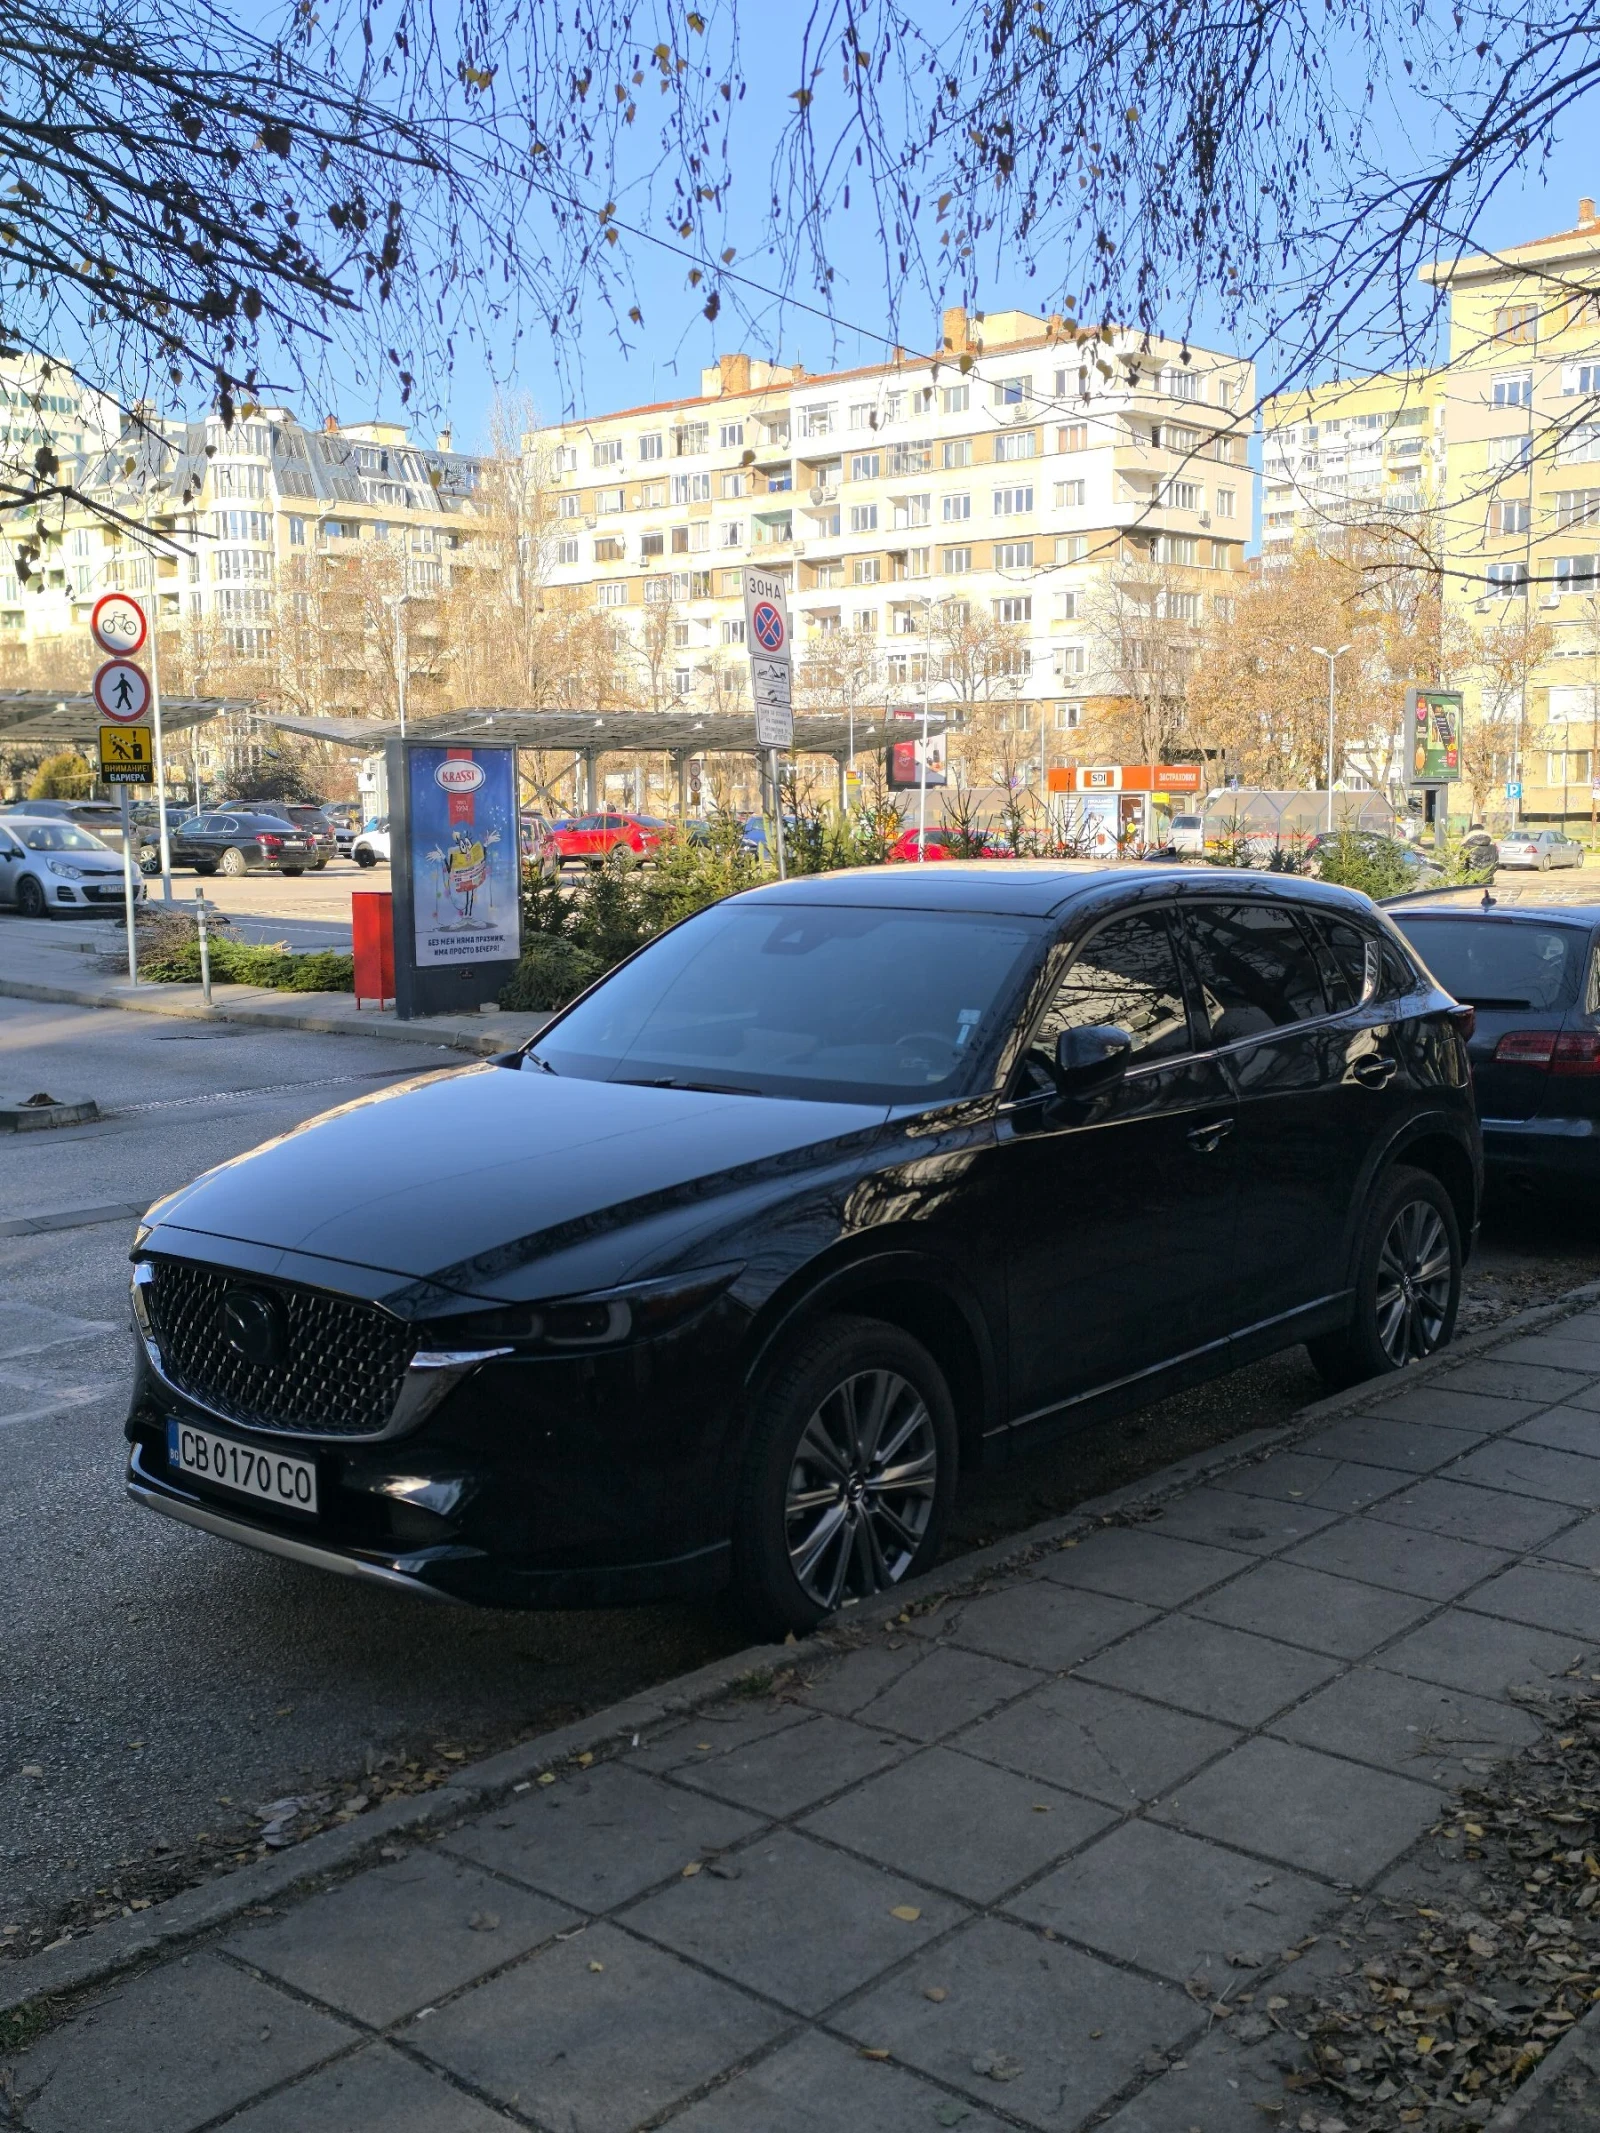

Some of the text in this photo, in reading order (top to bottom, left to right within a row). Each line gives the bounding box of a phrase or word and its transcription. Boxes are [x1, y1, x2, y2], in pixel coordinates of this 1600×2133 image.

[750, 577, 782, 600] ЗОНА
[110, 773, 146, 781] БАРИЕРА
[442, 769, 475, 783] KRASSI
[1092, 773, 1106, 782] SDI
[1509, 784, 1518, 796] P
[428, 938, 439, 946] БЕЗ
[456, 936, 475, 944] НЯМА
[434, 944, 500, 956] ИМА ПРОСТО ВЕЧЕРЯ!
[170, 1447, 179, 1461] BG
[181, 1430, 209, 1471] CB
[213, 1442, 271, 1493] 0170
